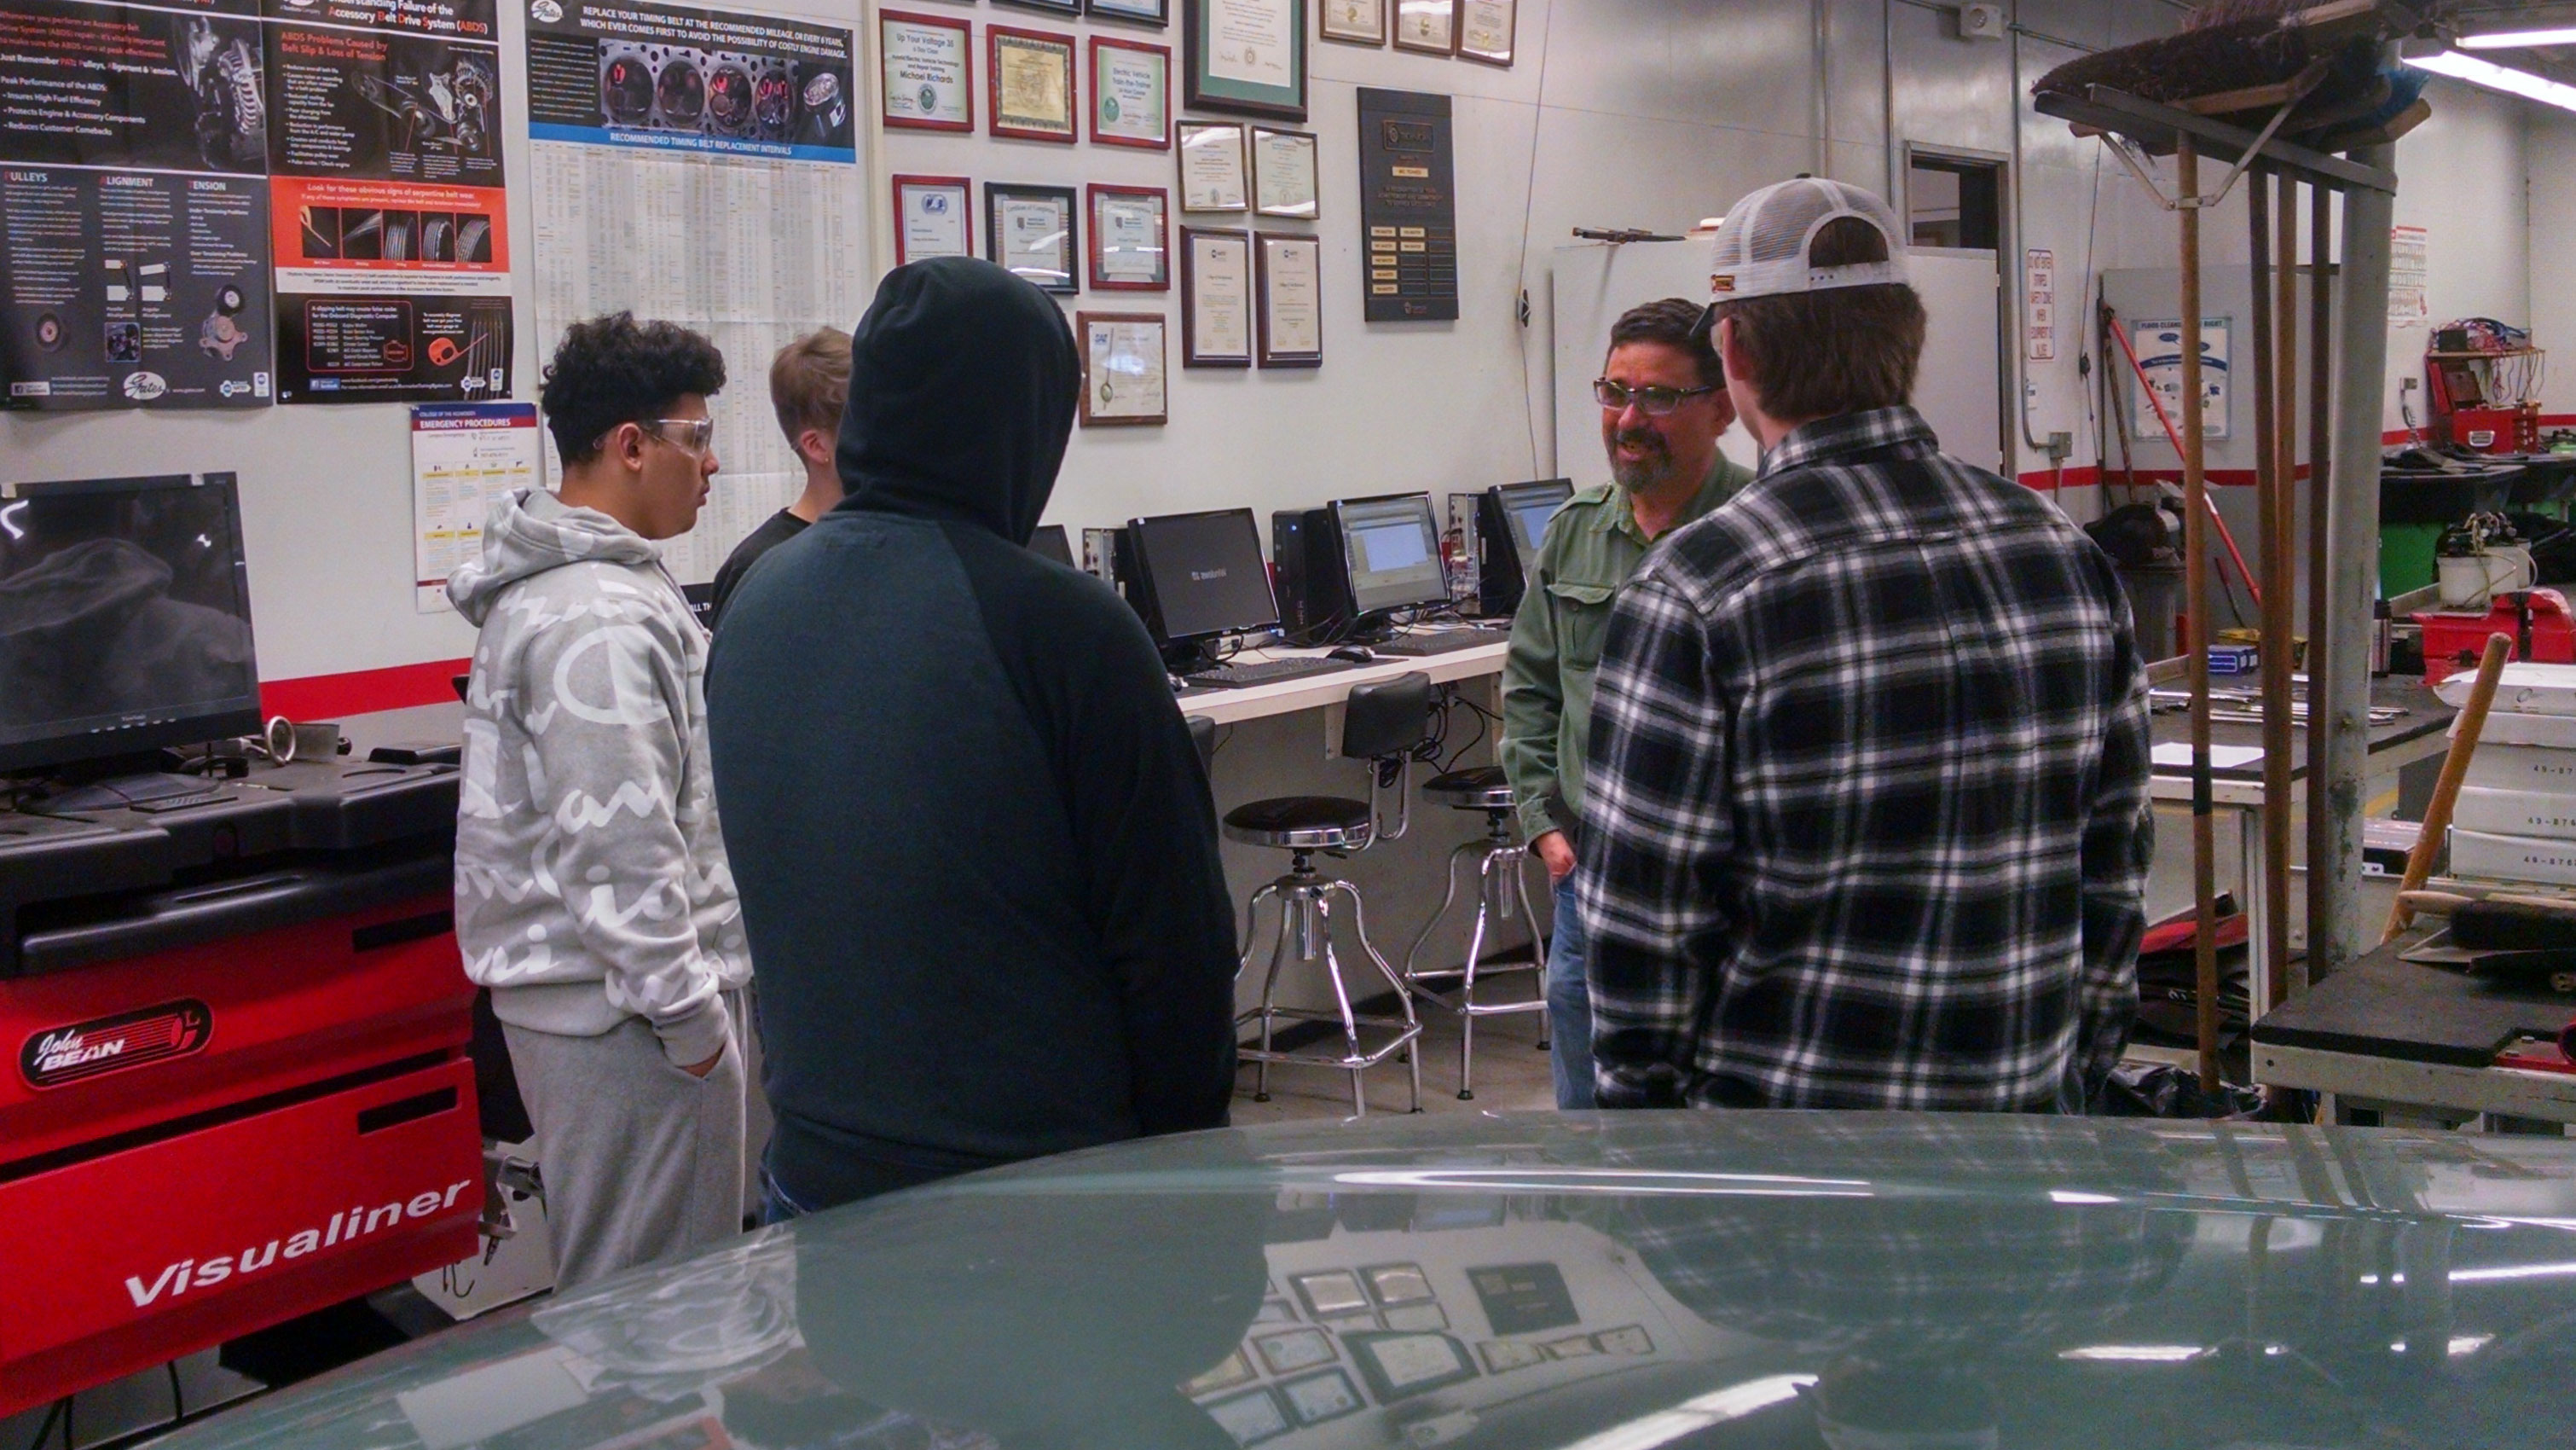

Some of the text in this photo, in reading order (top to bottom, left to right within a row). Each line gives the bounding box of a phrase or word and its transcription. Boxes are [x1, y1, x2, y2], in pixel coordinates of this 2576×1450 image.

[397, 0, 426, 12] Failure
[426, 3, 437, 14] of
[438, 3, 454, 15] the
[327, 6, 375, 23] Accessory
[377, 11, 396, 23] Belt
[397, 14, 420, 26] Drive
[422, 16, 454, 32] System
[456, 20, 488, 32] (ABDS)
[582, 5, 616, 18] REPLACE
[617, 9, 638, 20] YOUR
[640, 12, 665, 24] TIMING
[667, 15, 682, 26] BELT
[684, 18, 694, 27] AT
[696, 19, 708, 29] THE
[709, 20, 765, 37] RECOMMENDED
[794, 32, 802, 42] OR
[803, 33, 820, 44] EVERY
[281, 32, 387, 51] ABDS Problems Caused by
[580, 18, 606, 29] WHICH
[607, 20, 627, 32] EVER
[628, 23, 654, 35] COMES
[655, 26, 675, 37] FIRST
[677, 28, 686, 38] TO
[687, 30, 710, 41] AVOID
[711, 32, 725, 43] THE
[726, 34, 767, 48] POSSIBILITY
[768, 39, 777, 49] OF
[778, 41, 800, 52] COSTLY
[800, 44, 820, 55] ENGINE
[895, 32, 905, 43] Up
[906, 34, 920, 43] Your
[921, 36, 945, 48] Voltage
[281, 44, 298, 52] Belt
[300, 45, 315, 56] Slip
[327, 48, 344, 56] Loss
[356, 50, 385, 60] Tension
[899, 69, 953, 84] Michael Richards
[610, 132, 791, 154] RECOMMENDED TIMING BELT REPLACEMENT INTERVALS
[4, 171, 48, 183] PULLEYS
[99, 176, 153, 188] ALIGNMENT
[188, 179, 227, 191] TENSION
[420, 418, 511, 428] EMERGENCY PROCEDURES
[34, 1030, 84, 1065] John
[41, 1039, 124, 1072] BEAN
[124, 1179, 471, 1308] Visualiner
